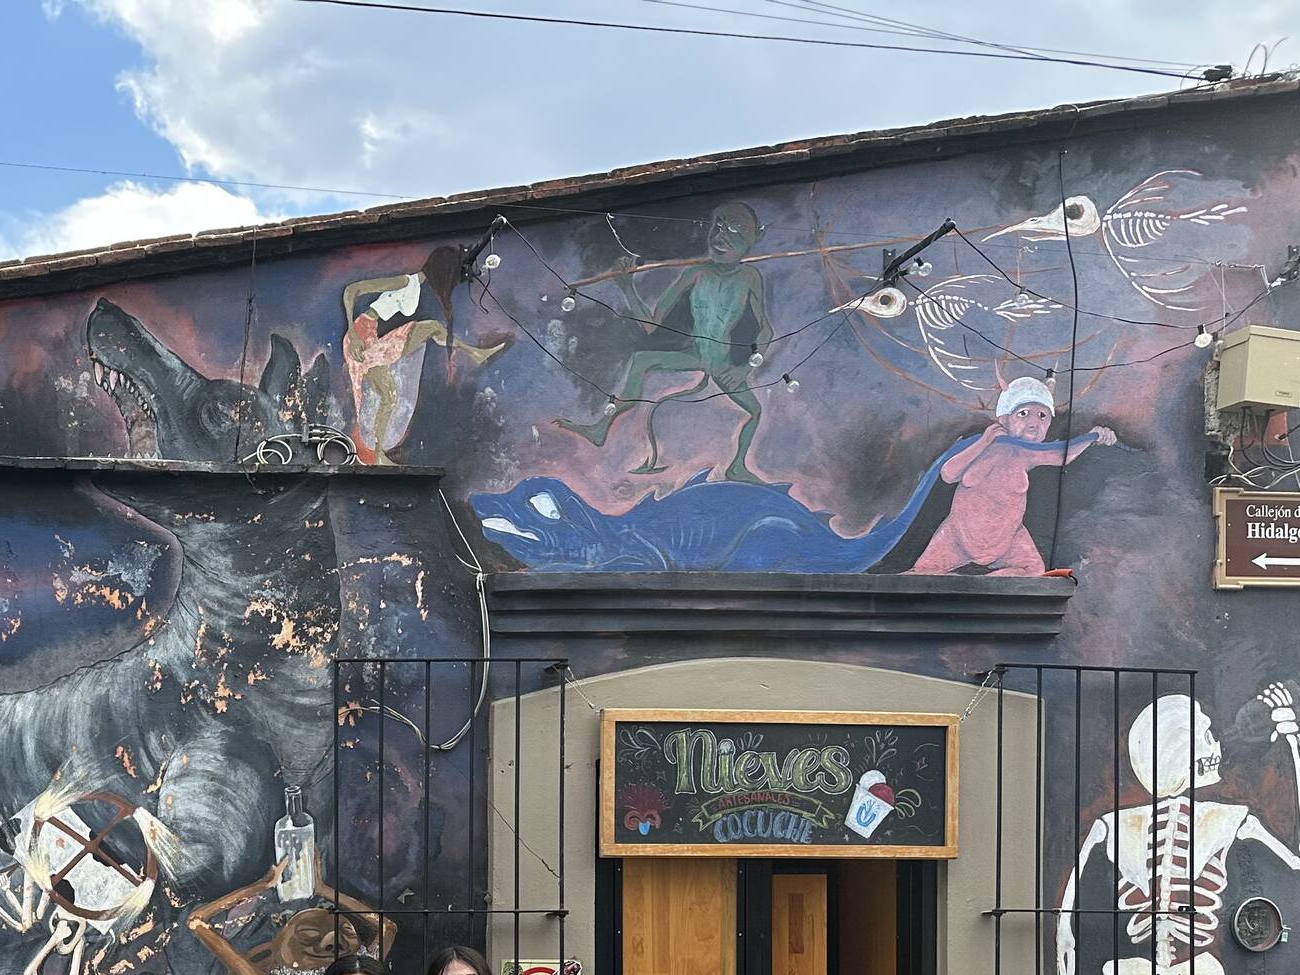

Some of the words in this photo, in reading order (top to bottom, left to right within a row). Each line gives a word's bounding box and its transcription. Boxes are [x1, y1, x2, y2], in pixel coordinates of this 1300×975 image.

[1246, 504, 1291, 521] Callejón
[1294, 505, 1300, 518] d
[1246, 522, 1300, 544] Hidalg
[664, 728, 853, 795] Nieves
[717, 792, 791, 810] ARTESANALES
